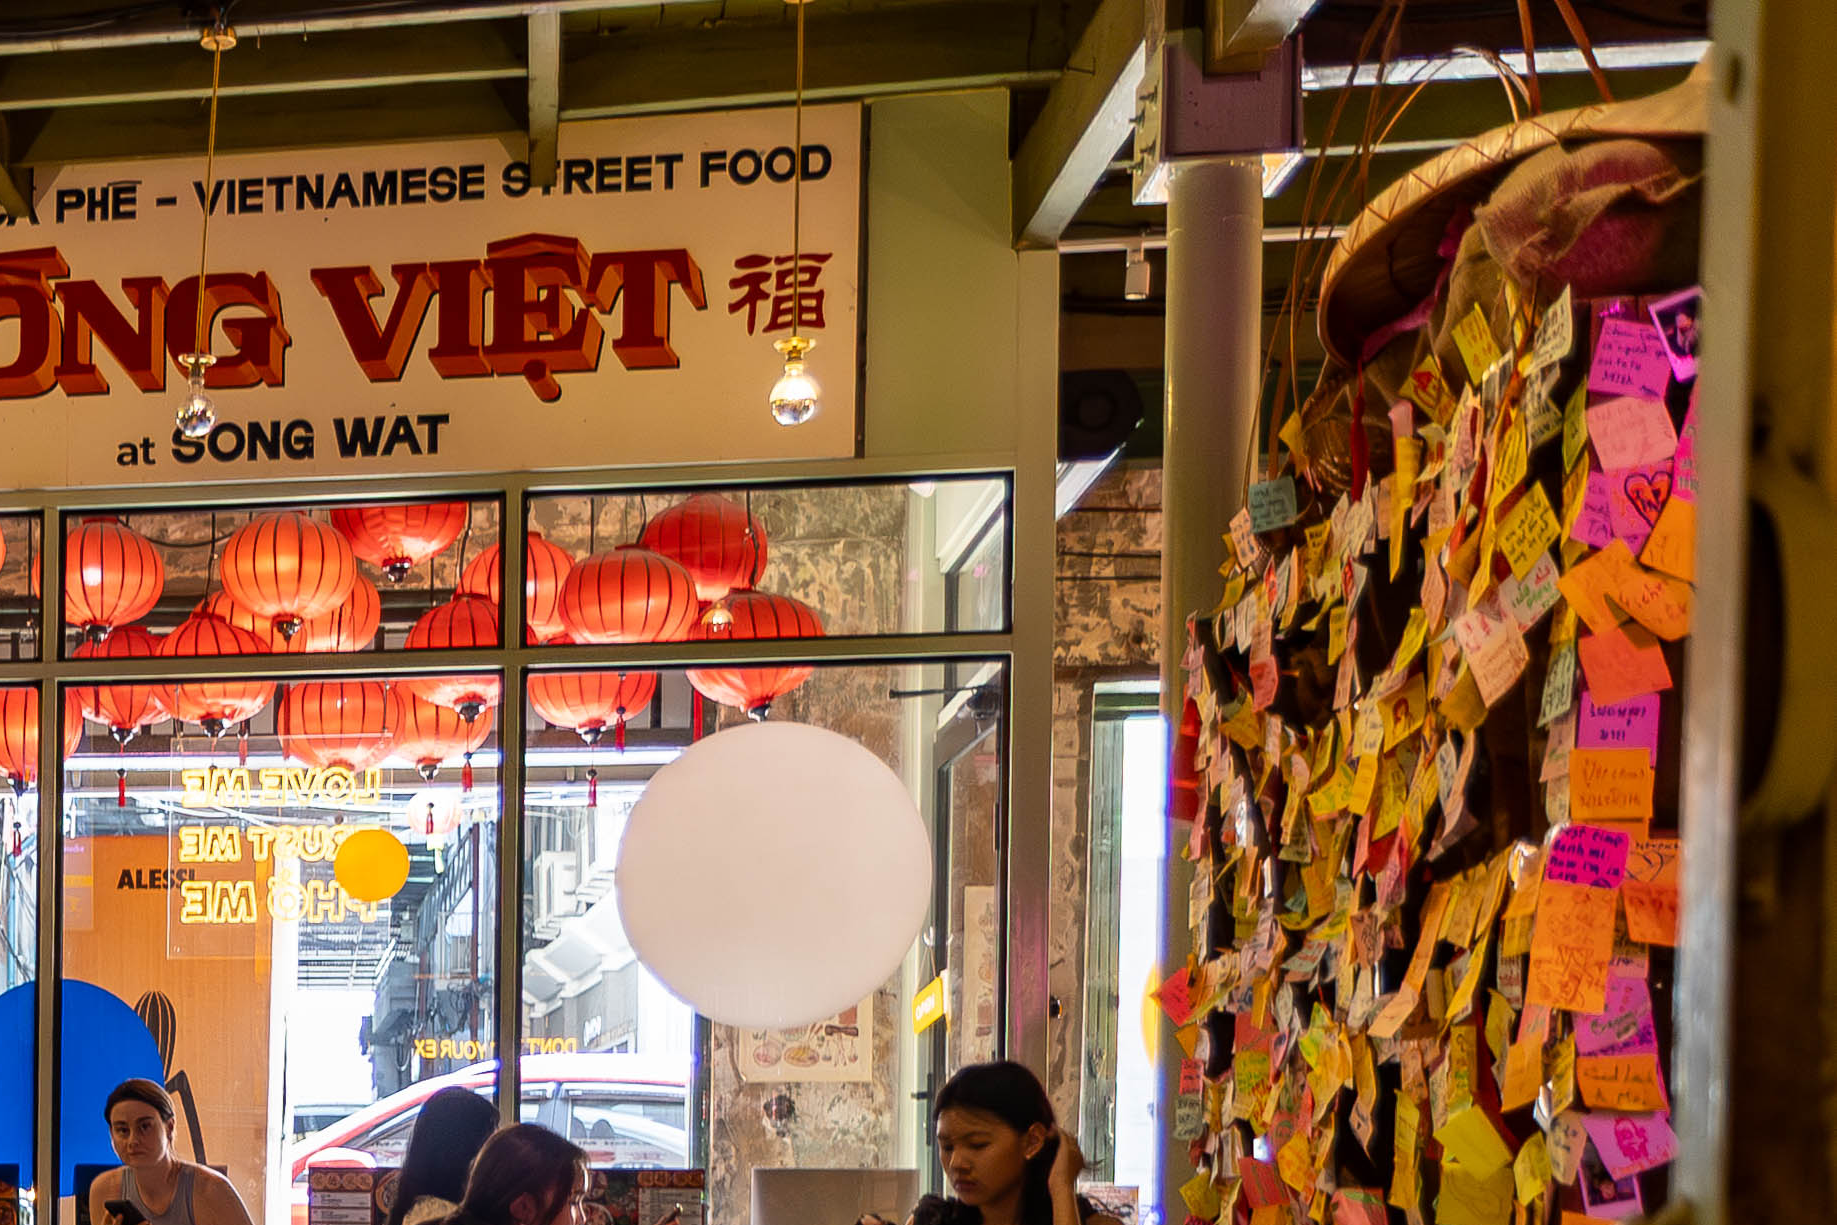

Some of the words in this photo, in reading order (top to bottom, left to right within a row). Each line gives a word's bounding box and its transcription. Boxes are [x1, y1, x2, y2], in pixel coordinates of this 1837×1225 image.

[193, 165, 485, 216] VIETNAMESE
[700, 144, 833, 188] FOOD
[729, 252, 833, 336] 福
[117, 437, 156, 466] at
[171, 420, 314, 464] SONG
[333, 414, 449, 458] WAT
[117, 868, 196, 890] ALESSI
